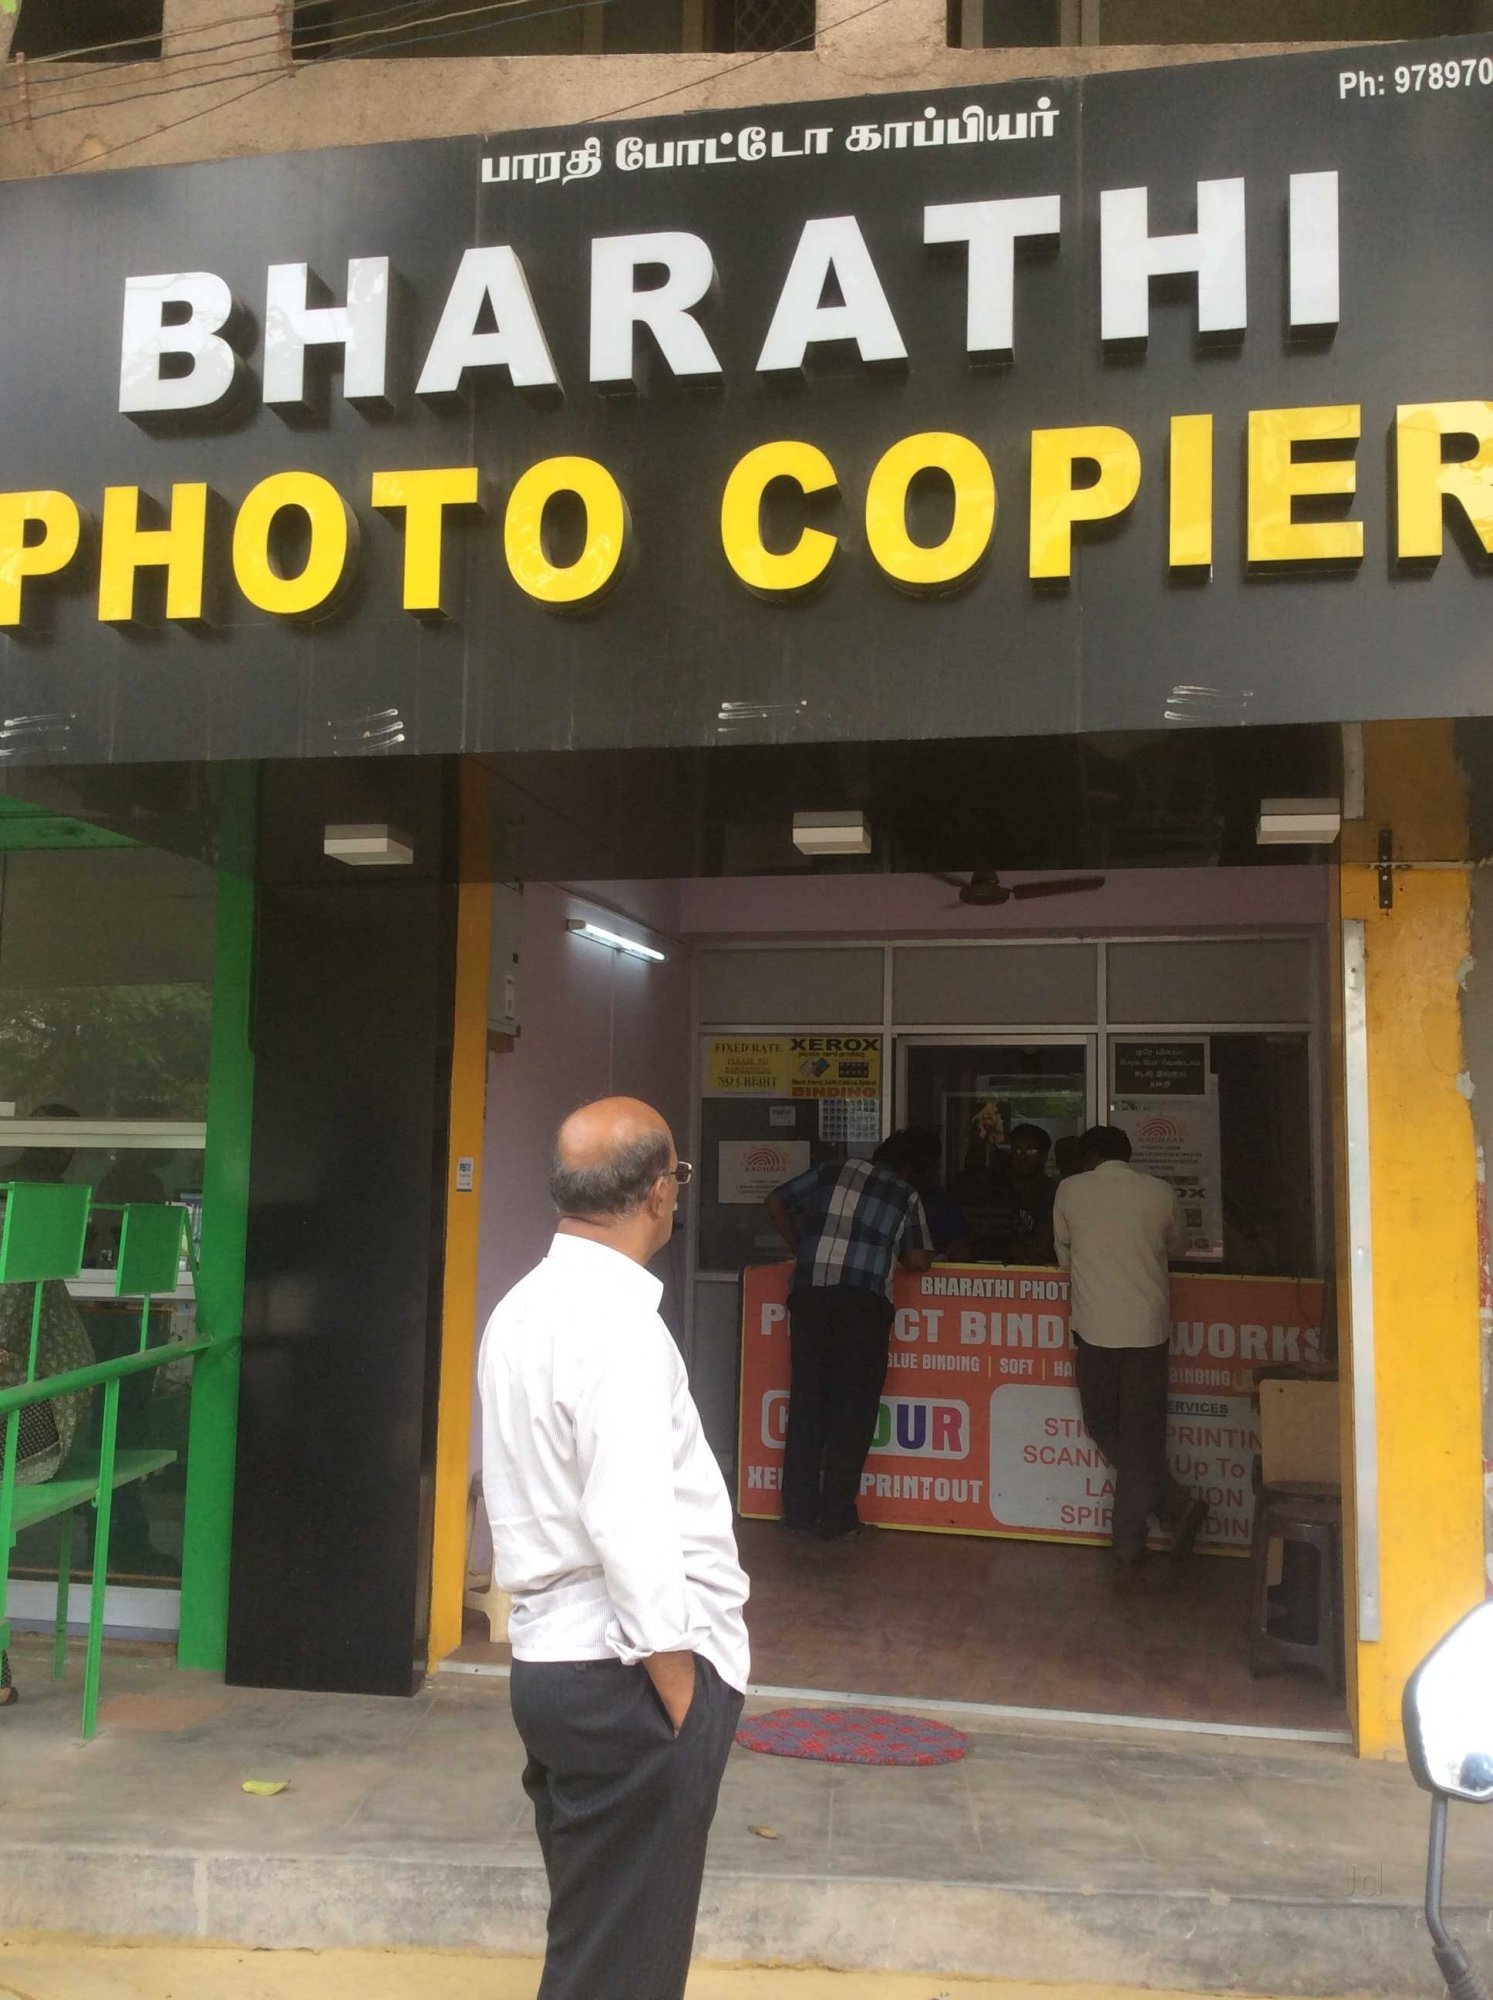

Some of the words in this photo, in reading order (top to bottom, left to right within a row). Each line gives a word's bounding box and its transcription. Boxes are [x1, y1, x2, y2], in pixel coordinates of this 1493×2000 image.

[1339, 70, 1385, 99] Ph:
[1393, 57, 1493, 94] 978970
[481, 137, 603, 186] பாரதி
[615, 126, 834, 172] போட்டோ
[845, 96, 1060, 152] காப்பியர்
[119, 170, 1341, 414] BHARATHI
[0, 456, 626, 626] PHOTO
[720, 400, 1493, 592] COPIER
[715, 1043, 749, 1053] FIXED
[752, 1043, 782, 1053] RATE
[790, 1038, 878, 1051] XEROX
[791, 1087, 876, 1097] BINDING
[920, 1276, 1014, 1299] BHARATHI
[1019, 1279, 1070, 1302] PHOT
[1168, 1321, 1324, 1363] WORKS
[922, 1353, 980, 1373] BINDING
[1000, 1356, 1035, 1377] SOFT
[1167, 1400, 1229, 1414] ERVICES
[1216, 1458, 1245, 1479] To
[860, 1472, 984, 1504] PRINTOUT
